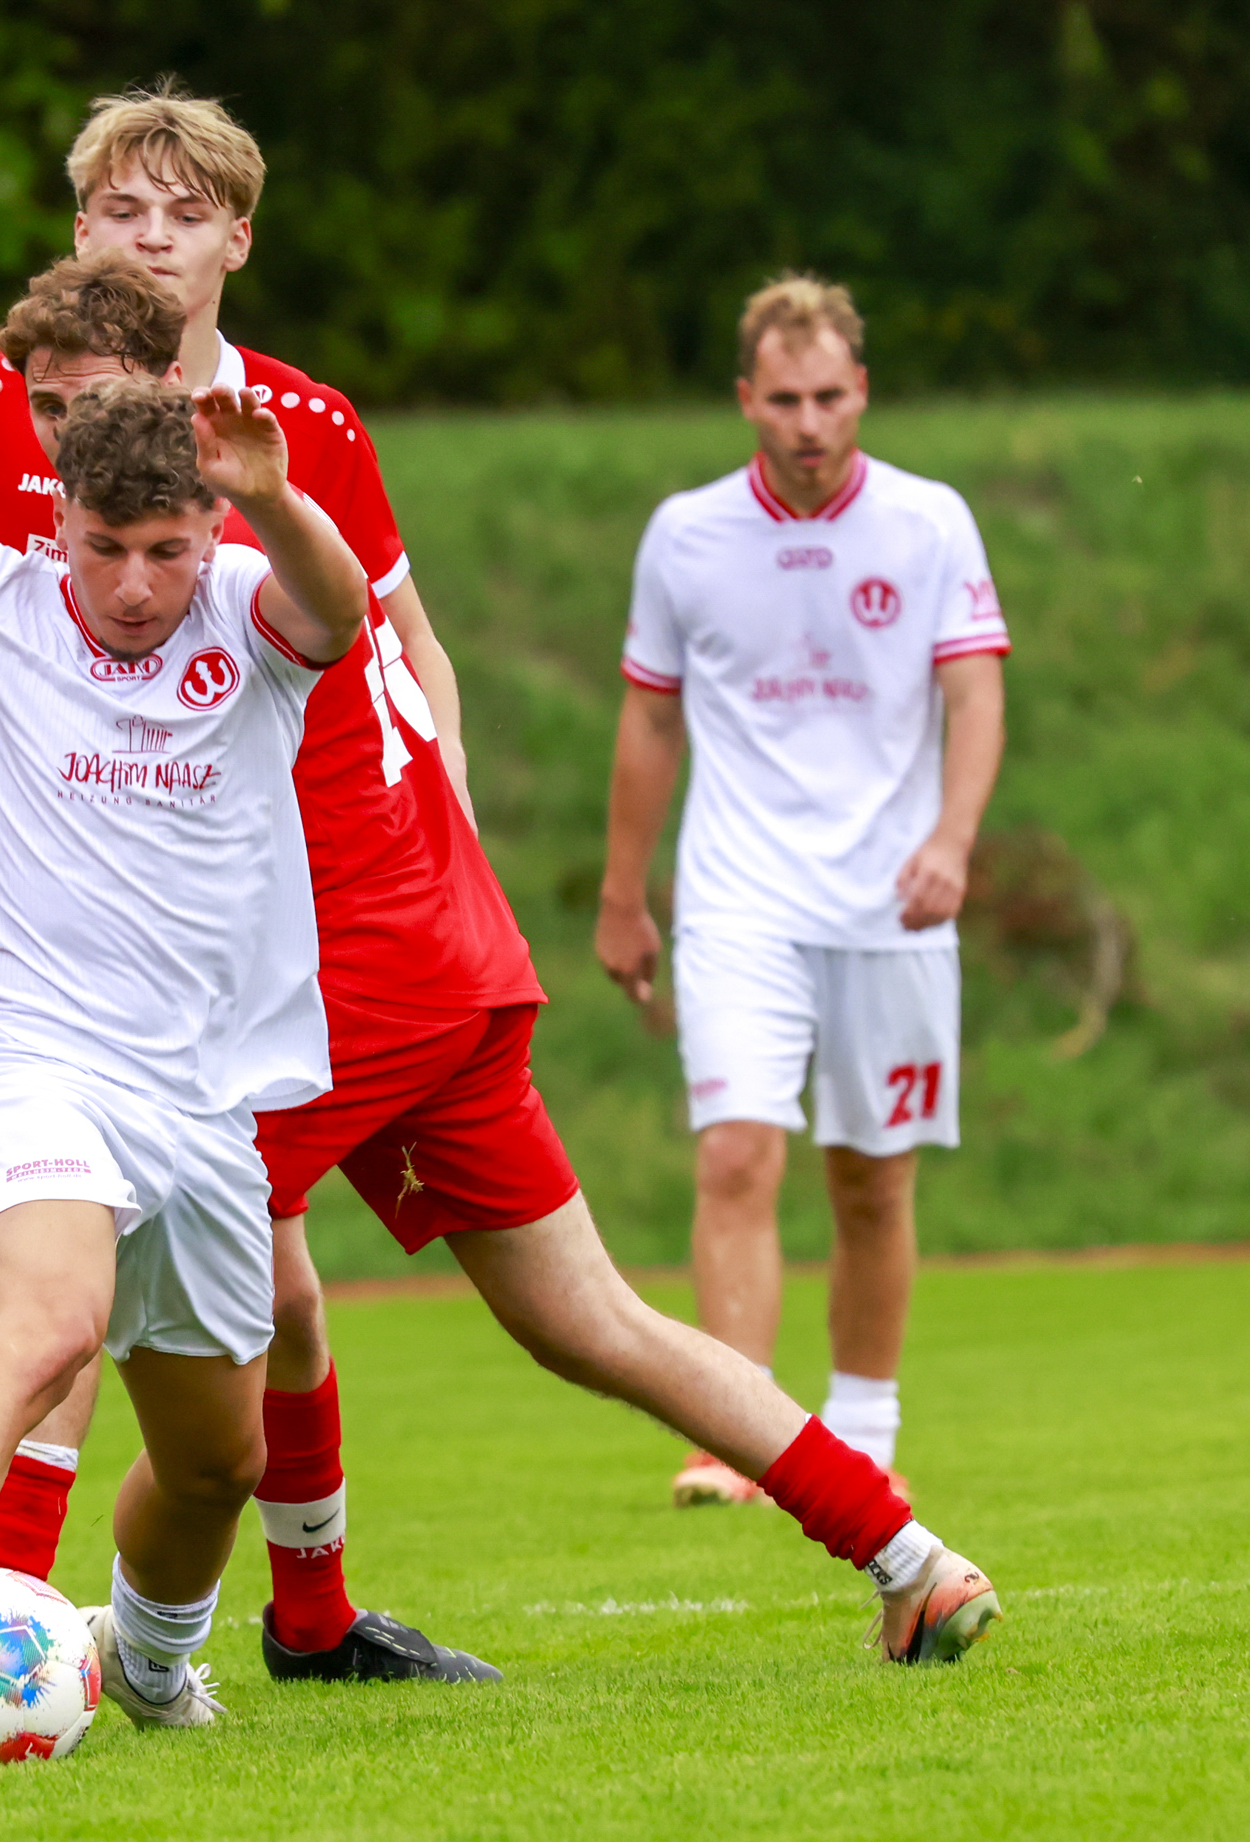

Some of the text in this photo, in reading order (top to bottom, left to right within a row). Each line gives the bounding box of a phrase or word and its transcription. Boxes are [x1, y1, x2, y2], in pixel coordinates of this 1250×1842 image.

[117, 674, 141, 682] SPORT
[883, 1060, 943, 1128] 21
[6, 1158, 91, 1177] SPORT-HOLL
